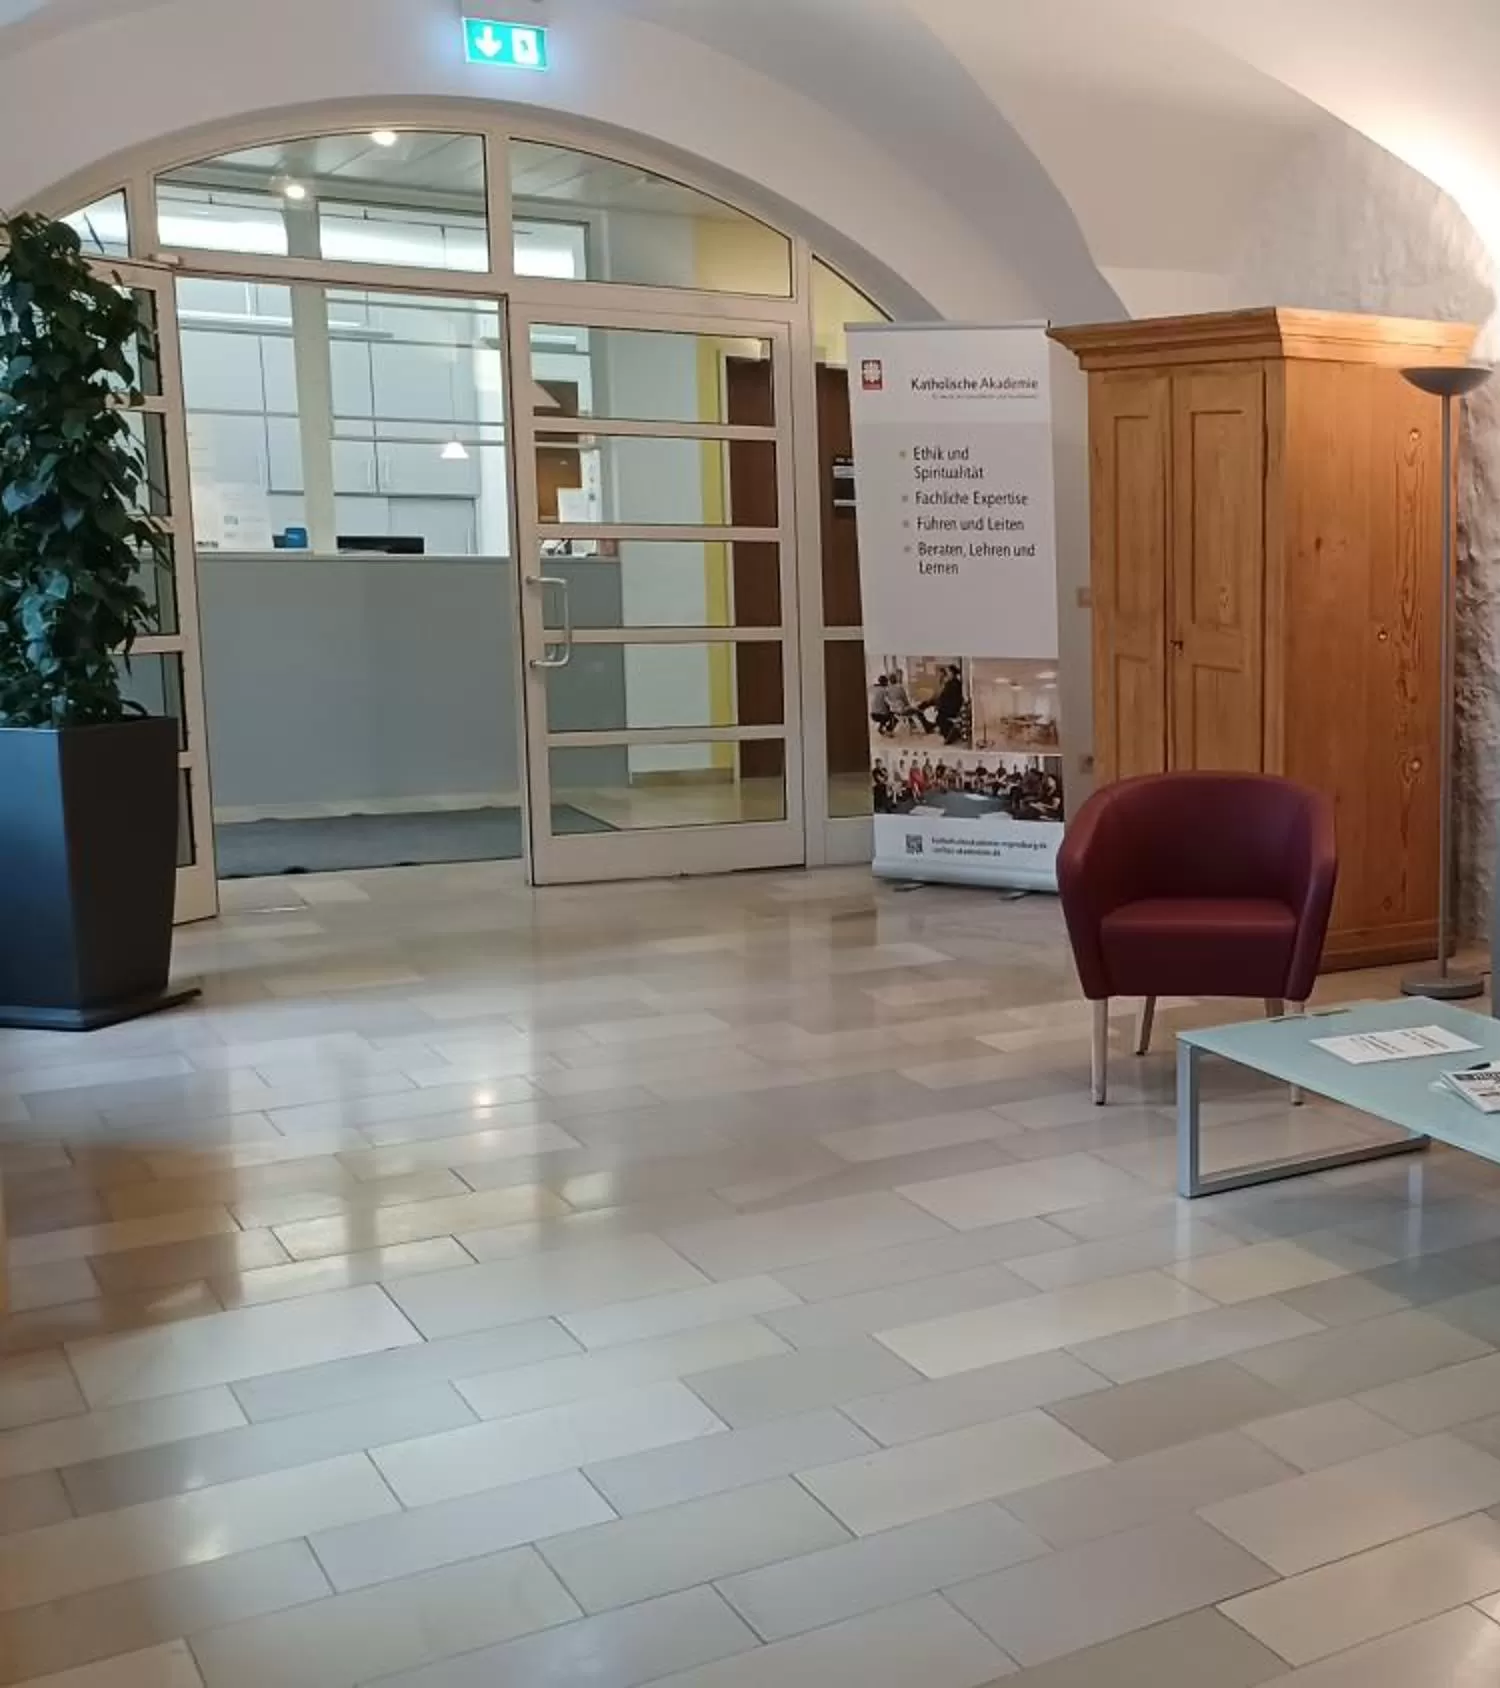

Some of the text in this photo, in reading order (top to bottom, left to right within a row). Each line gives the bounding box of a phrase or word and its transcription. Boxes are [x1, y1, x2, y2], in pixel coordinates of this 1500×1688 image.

[911, 377, 1039, 391] Katholische Akademie
[913, 446, 969, 461] Ethik und
[913, 465, 984, 483] Spiritualität
[915, 490, 1029, 508] Fachliche Expertise
[960, 516, 984, 531] und
[987, 516, 1025, 531] Leiten
[969, 542, 1011, 557] Lehren
[1013, 543, 1036, 557] und
[919, 560, 959, 575] Lernen
